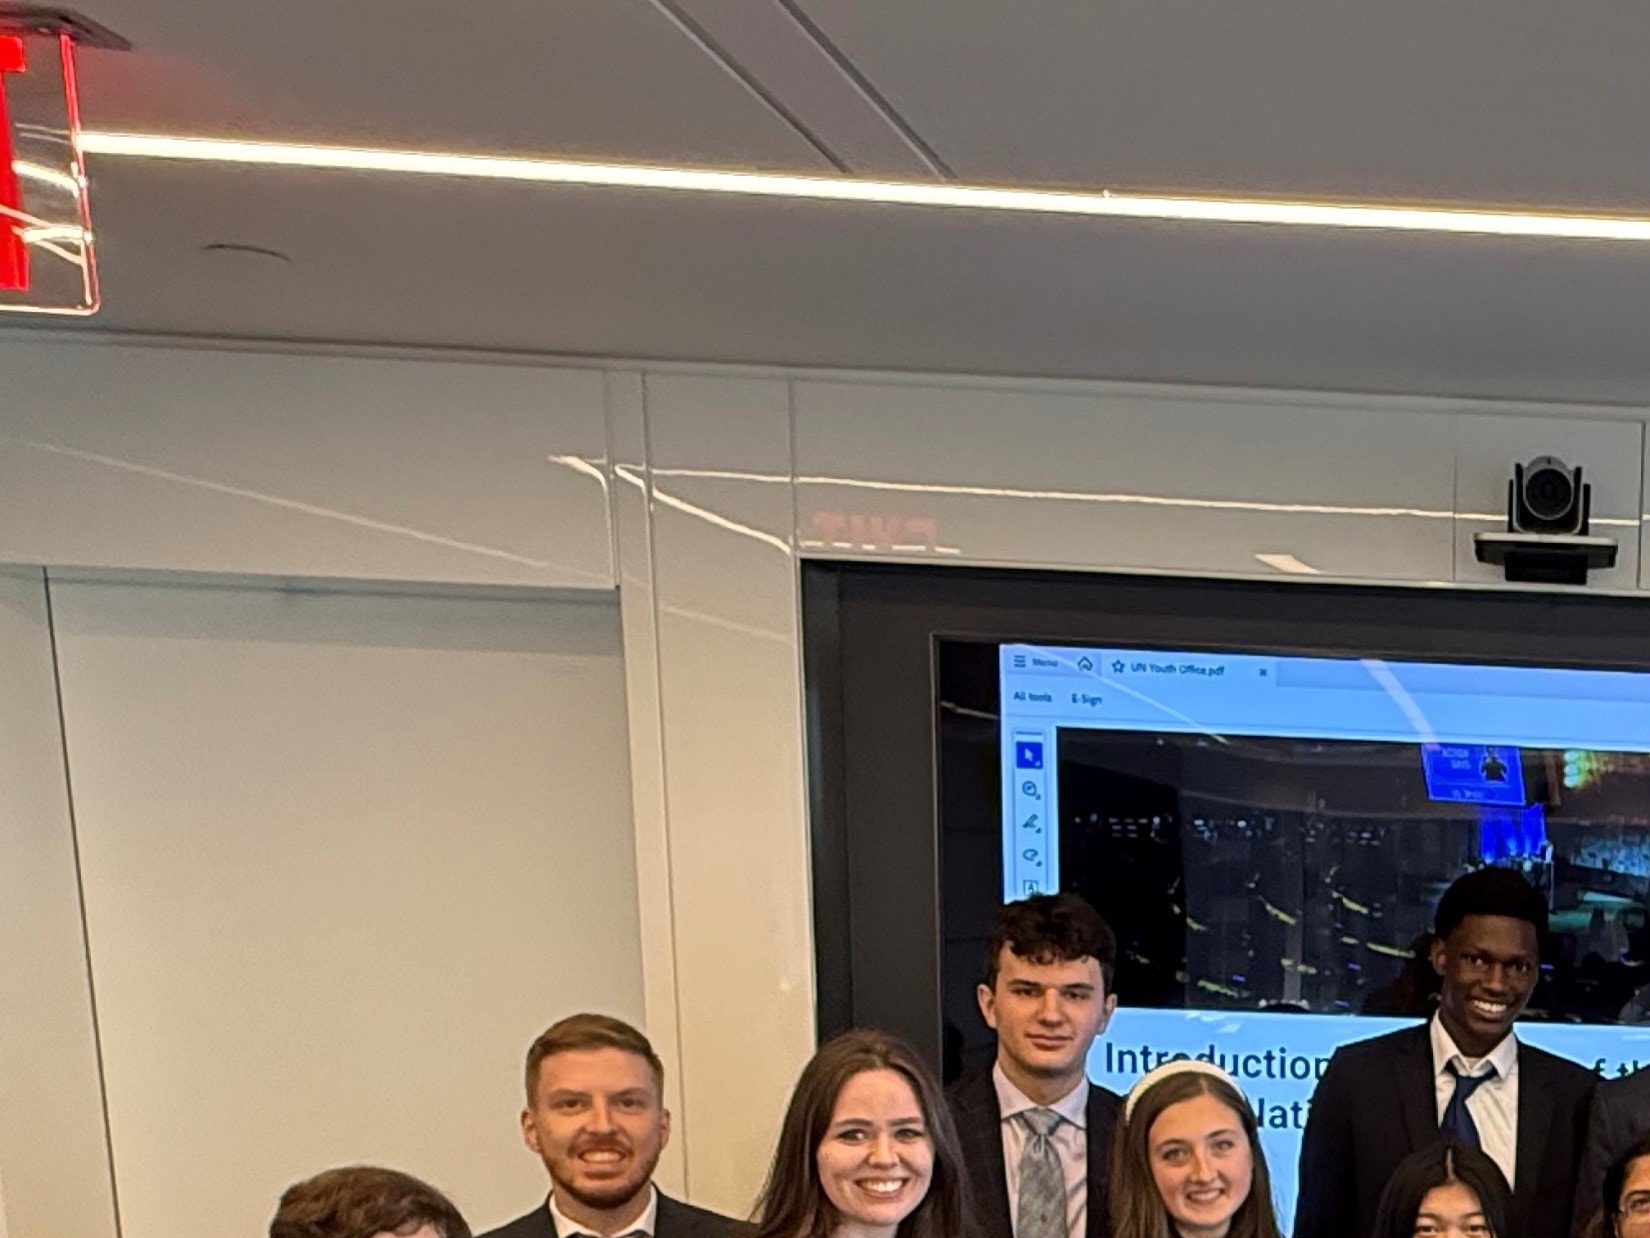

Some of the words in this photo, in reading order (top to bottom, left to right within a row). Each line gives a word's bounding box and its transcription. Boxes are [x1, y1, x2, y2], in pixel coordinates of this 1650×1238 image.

[1130, 663, 1147, 673] UN
[1149, 663, 1177, 674] Youth
[1106, 1042, 1331, 1080] Intrduction
